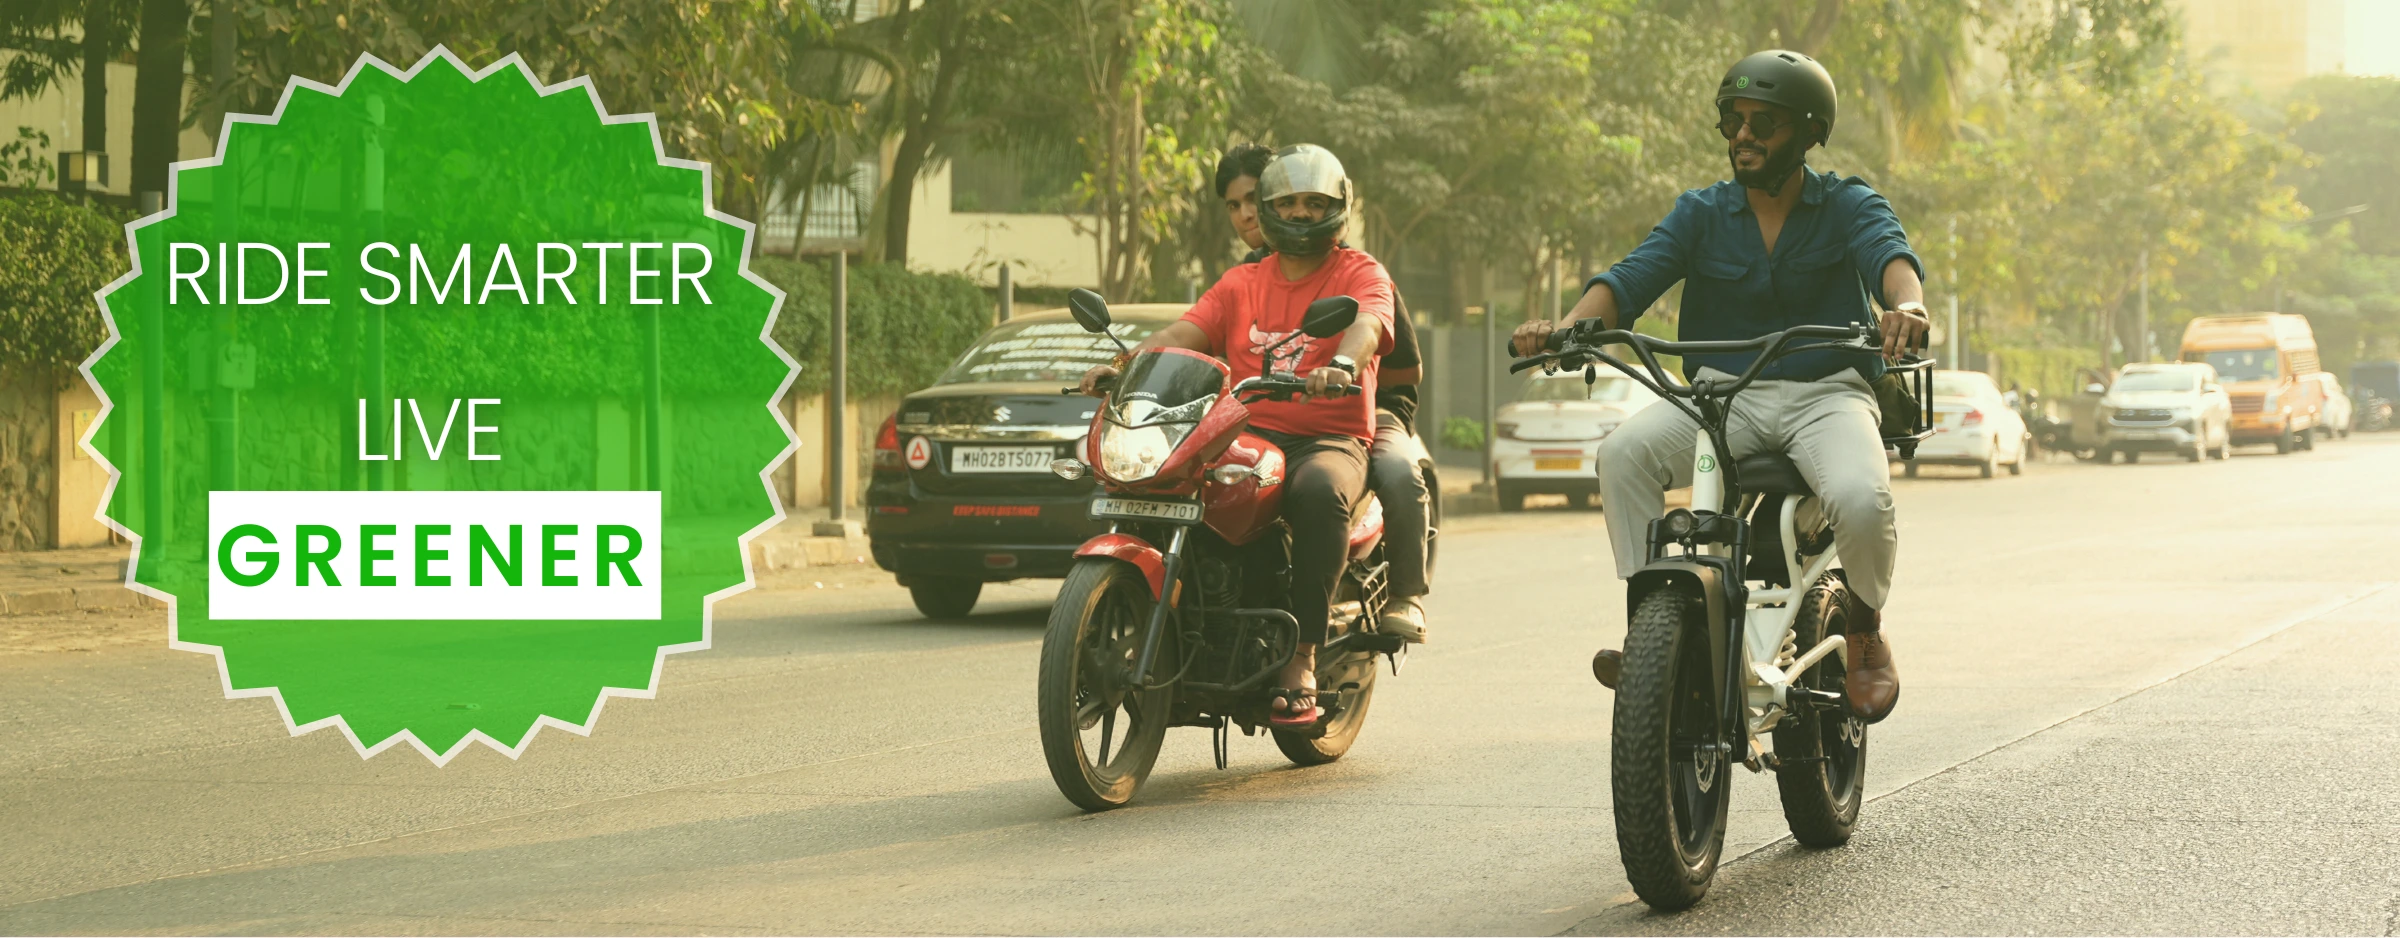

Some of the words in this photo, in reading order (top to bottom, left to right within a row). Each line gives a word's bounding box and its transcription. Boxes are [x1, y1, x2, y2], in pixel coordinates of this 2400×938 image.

[1124, 391, 1158, 399] HONDA
[962, 454, 1051, 468] MH02BT5077
[1105, 500, 1122, 513] MH
[1163, 504, 1195, 518] 7101
